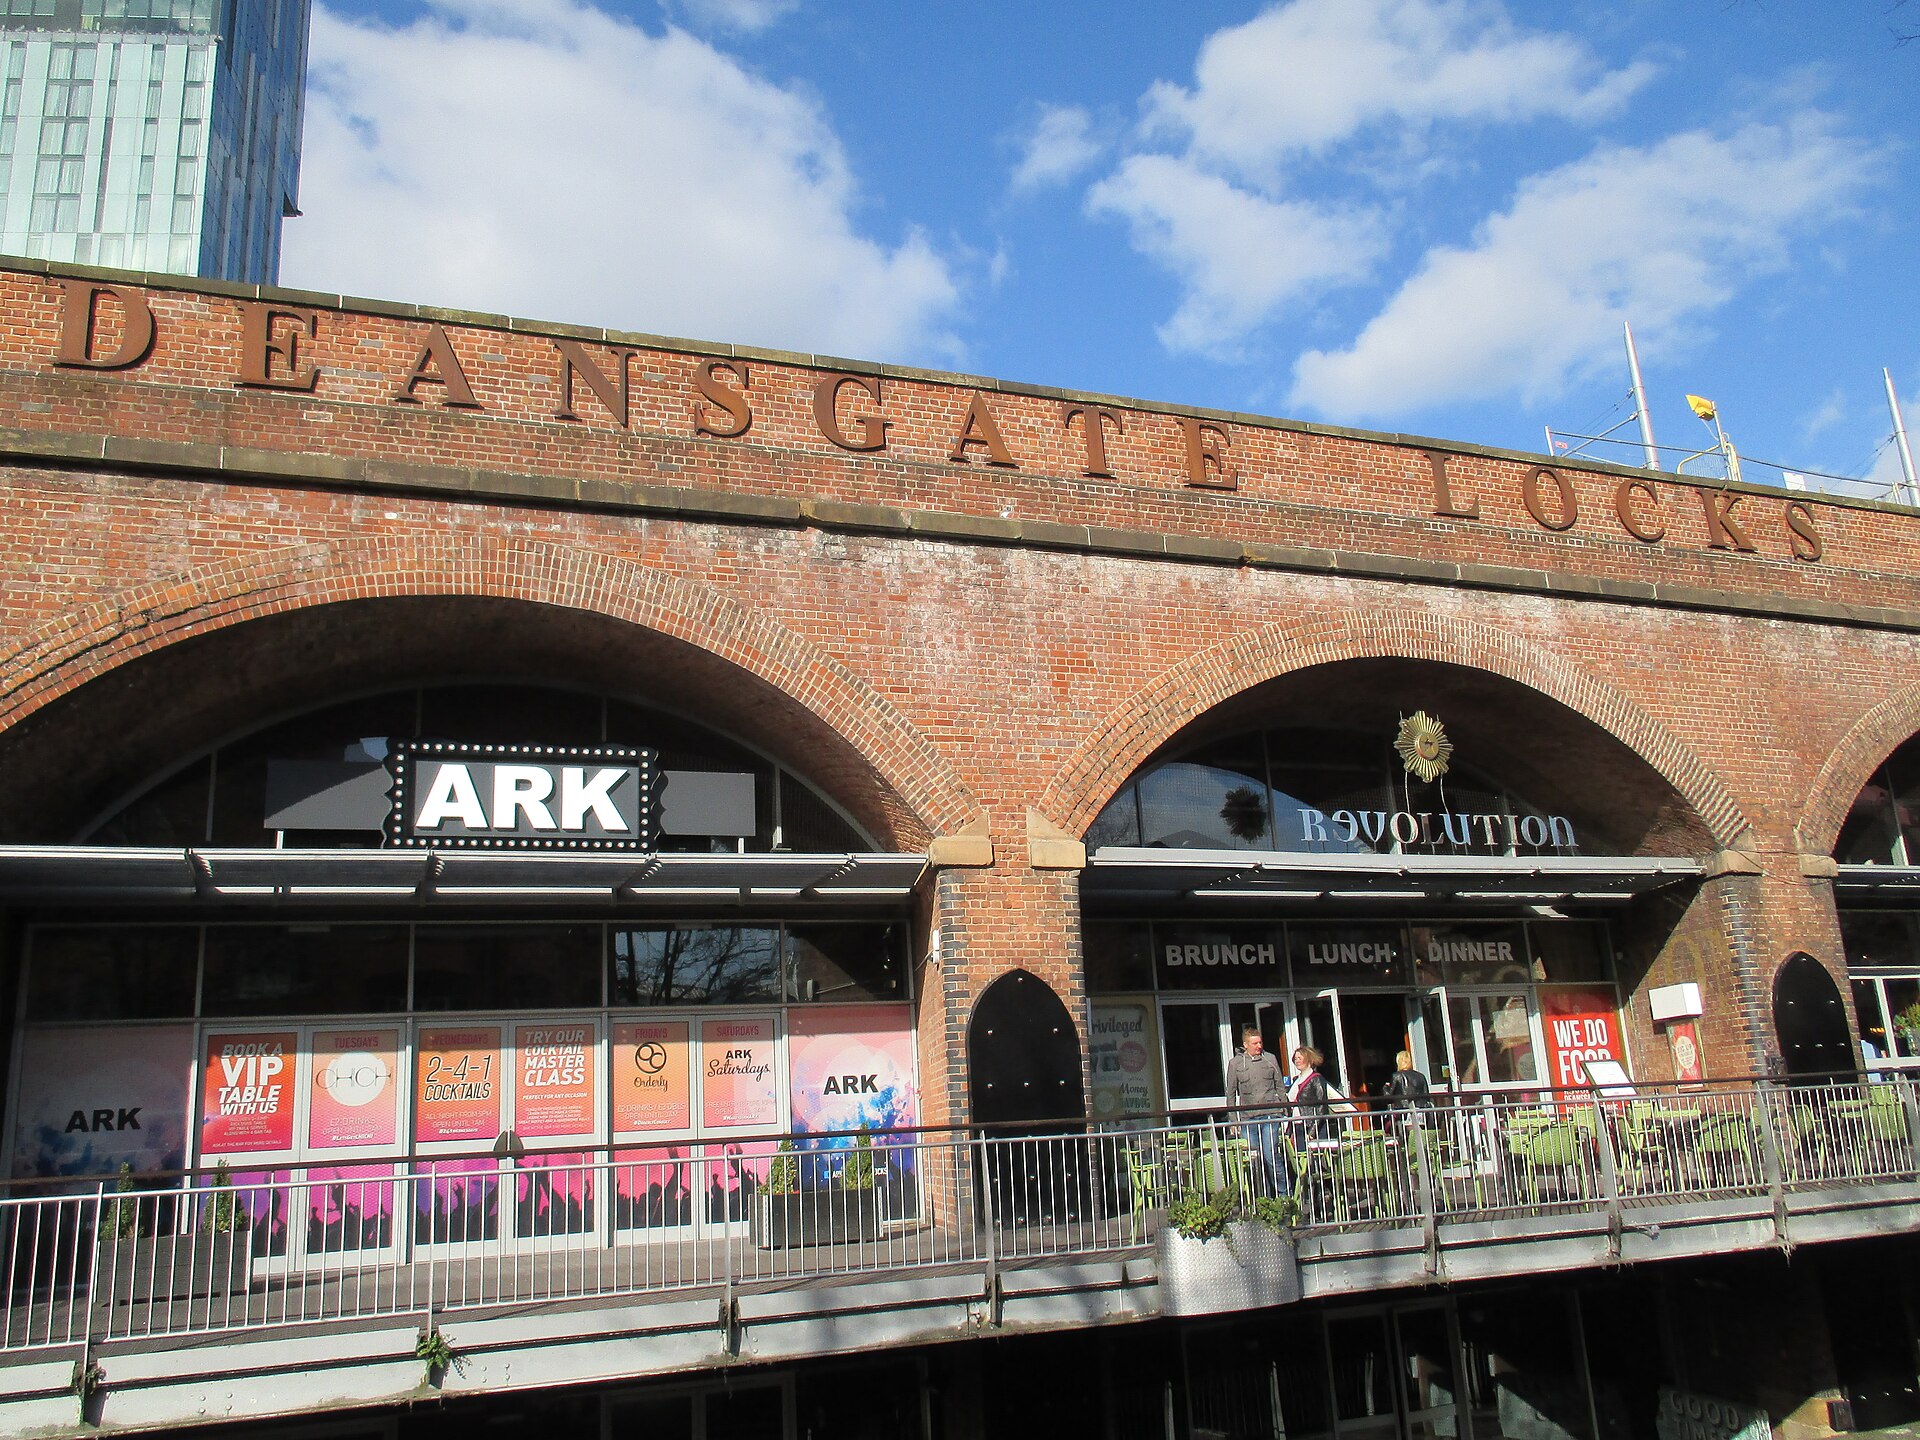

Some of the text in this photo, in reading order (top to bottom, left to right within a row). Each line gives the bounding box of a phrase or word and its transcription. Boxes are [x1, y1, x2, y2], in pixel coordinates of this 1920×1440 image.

[53, 278, 1823, 562] DEANSGATE LOCKS
[415, 764, 630, 832] ARK
[1165, 943, 1276, 967] BRUNCH
[1308, 943, 1393, 966] LUNCH
[1427, 941, 1515, 963] DINNER
[525, 1030, 585, 1044] TRY OUR
[635, 1028, 668, 1039] FRIDAYS
[717, 1025, 760, 1036] SATURDAYS
[1092, 1016, 1143, 1038] rivileged
[1552, 1018, 1609, 1048] WE DO
[334, 1036, 379, 1049] TUESDAYS
[432, 1034, 488, 1046] WEDNESDAYS
[524, 1044, 585, 1056] COCKTAIL
[221, 1043, 284, 1058] BOOK A
[725, 1049, 752, 1059] ARK
[220, 1056, 284, 1087] VIP
[426, 1054, 493, 1083] 2-4-1
[525, 1055, 585, 1070] MASTER
[707, 1058, 771, 1082] Saturdays
[524, 1068, 585, 1087] CLASS
[633, 1075, 668, 1092] Orderly
[823, 1074, 879, 1095] ARK
[218, 1085, 282, 1104] TABLE
[424, 1081, 492, 1102] COCKTAILS
[1119, 1083, 1149, 1097] Money
[220, 1102, 278, 1116] WITH US
[64, 1107, 142, 1133] ARK
[1669, 1390, 1739, 1430] GOOD
